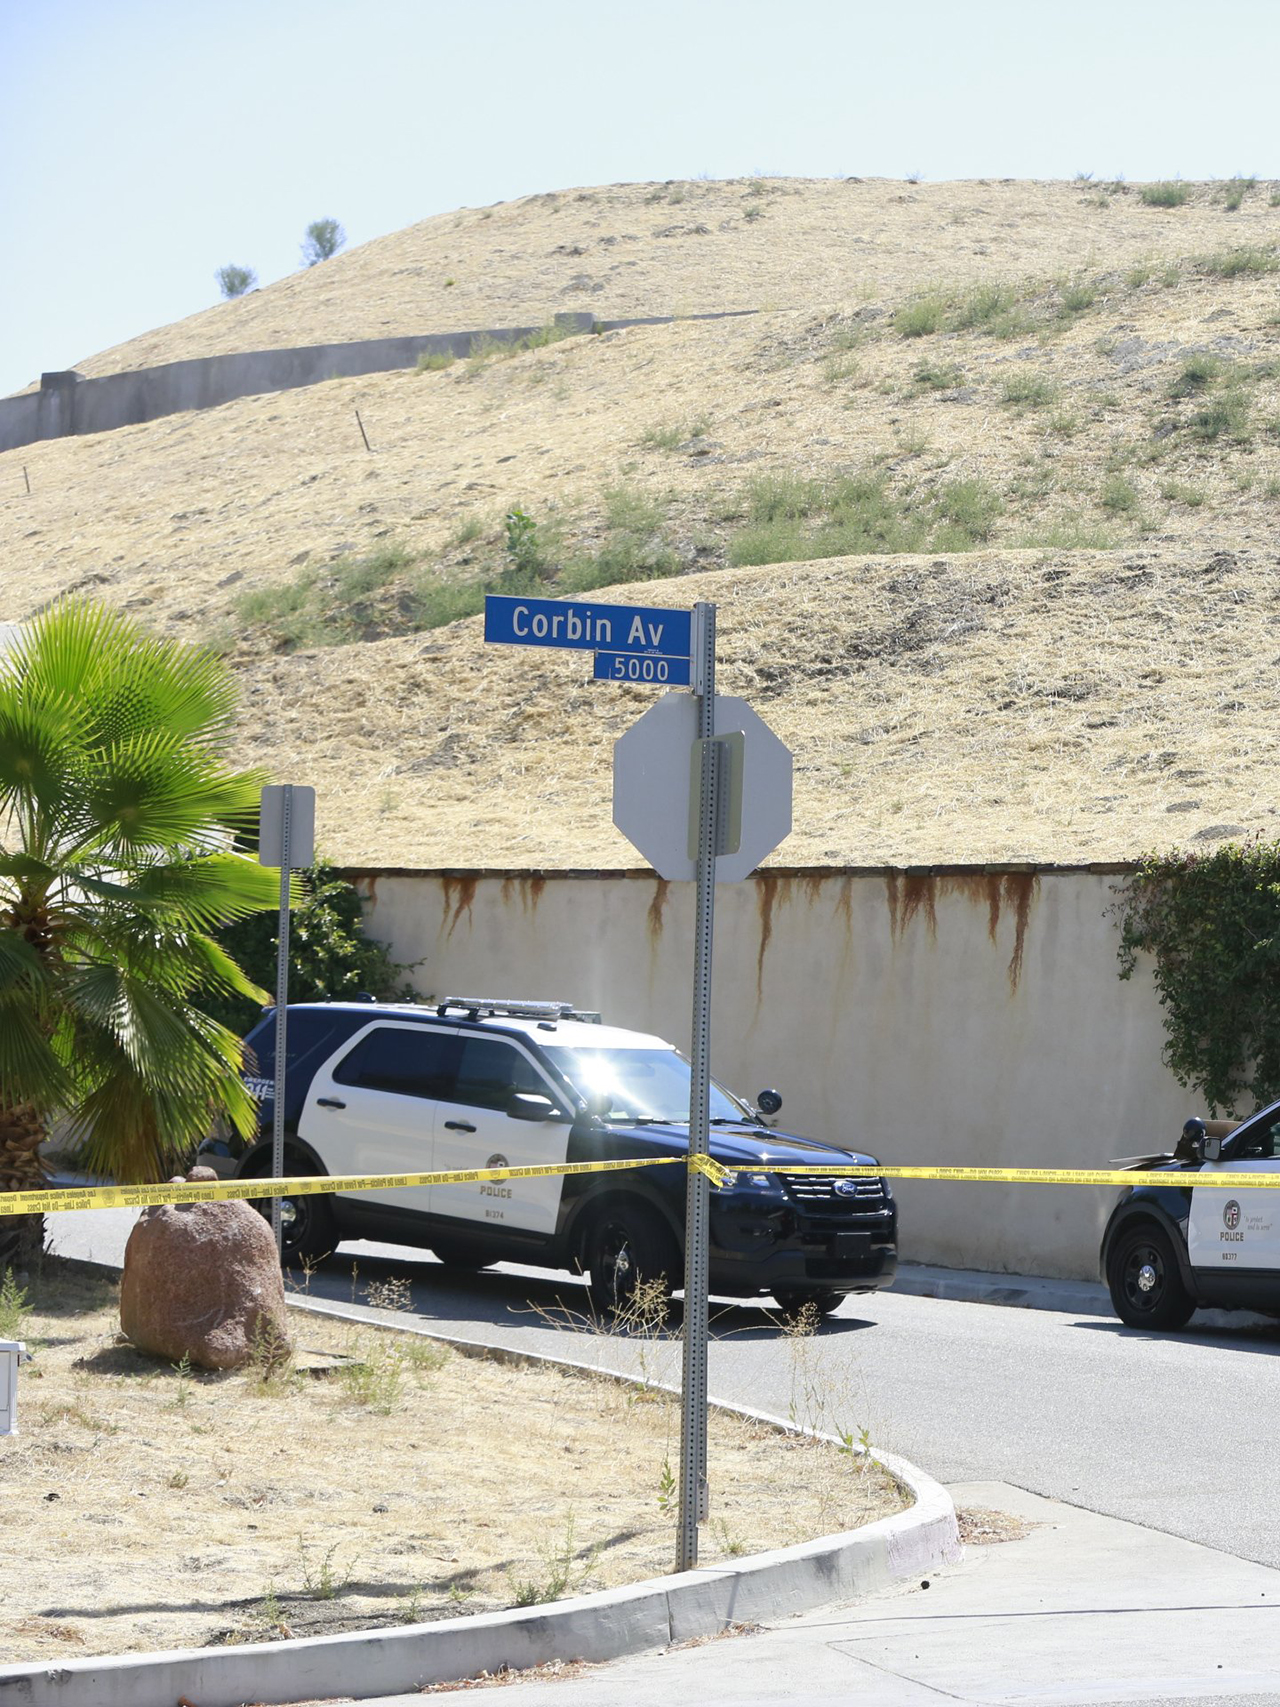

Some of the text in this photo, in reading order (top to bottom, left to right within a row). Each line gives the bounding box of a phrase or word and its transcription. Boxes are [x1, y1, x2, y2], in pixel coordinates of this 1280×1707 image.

[512, 606, 664, 646] Corbin Av
[614, 657, 668, 681] 5000
[480, 1186, 512, 1198] POLICE
[1220, 1232, 1244, 1241] POLICE
